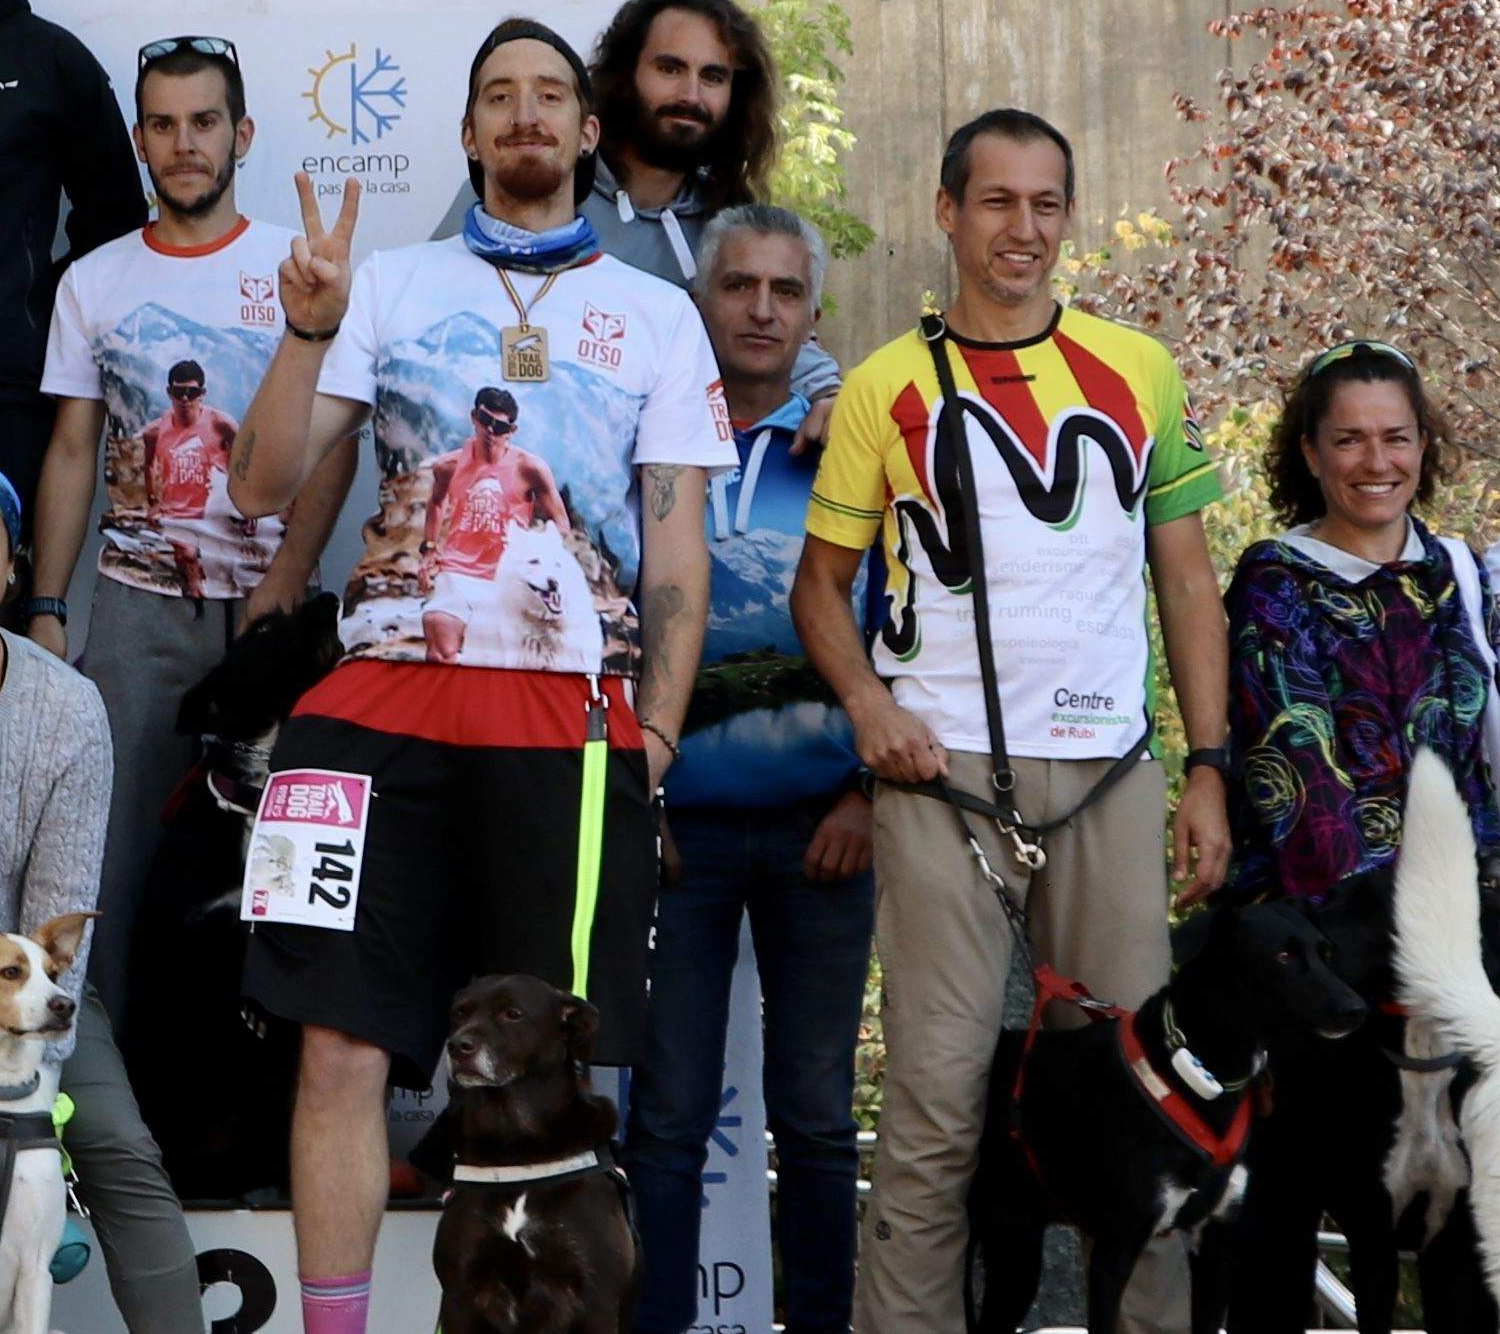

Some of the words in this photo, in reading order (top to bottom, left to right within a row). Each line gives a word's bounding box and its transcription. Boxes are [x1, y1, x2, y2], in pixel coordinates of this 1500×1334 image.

[302, 154, 410, 179] encamp
[366, 178, 378, 194] la
[380, 181, 411, 194] casa
[241, 305, 275, 322] OTSO
[577, 339, 622, 367] OTSO
[519, 364, 543, 378] DOG
[1054, 688, 1114, 710] Centre
[1050, 726, 1066, 739] de
[286, 784, 310, 818] DOG
[307, 784, 327, 819] TRAIL
[308, 839, 356, 909] 142
